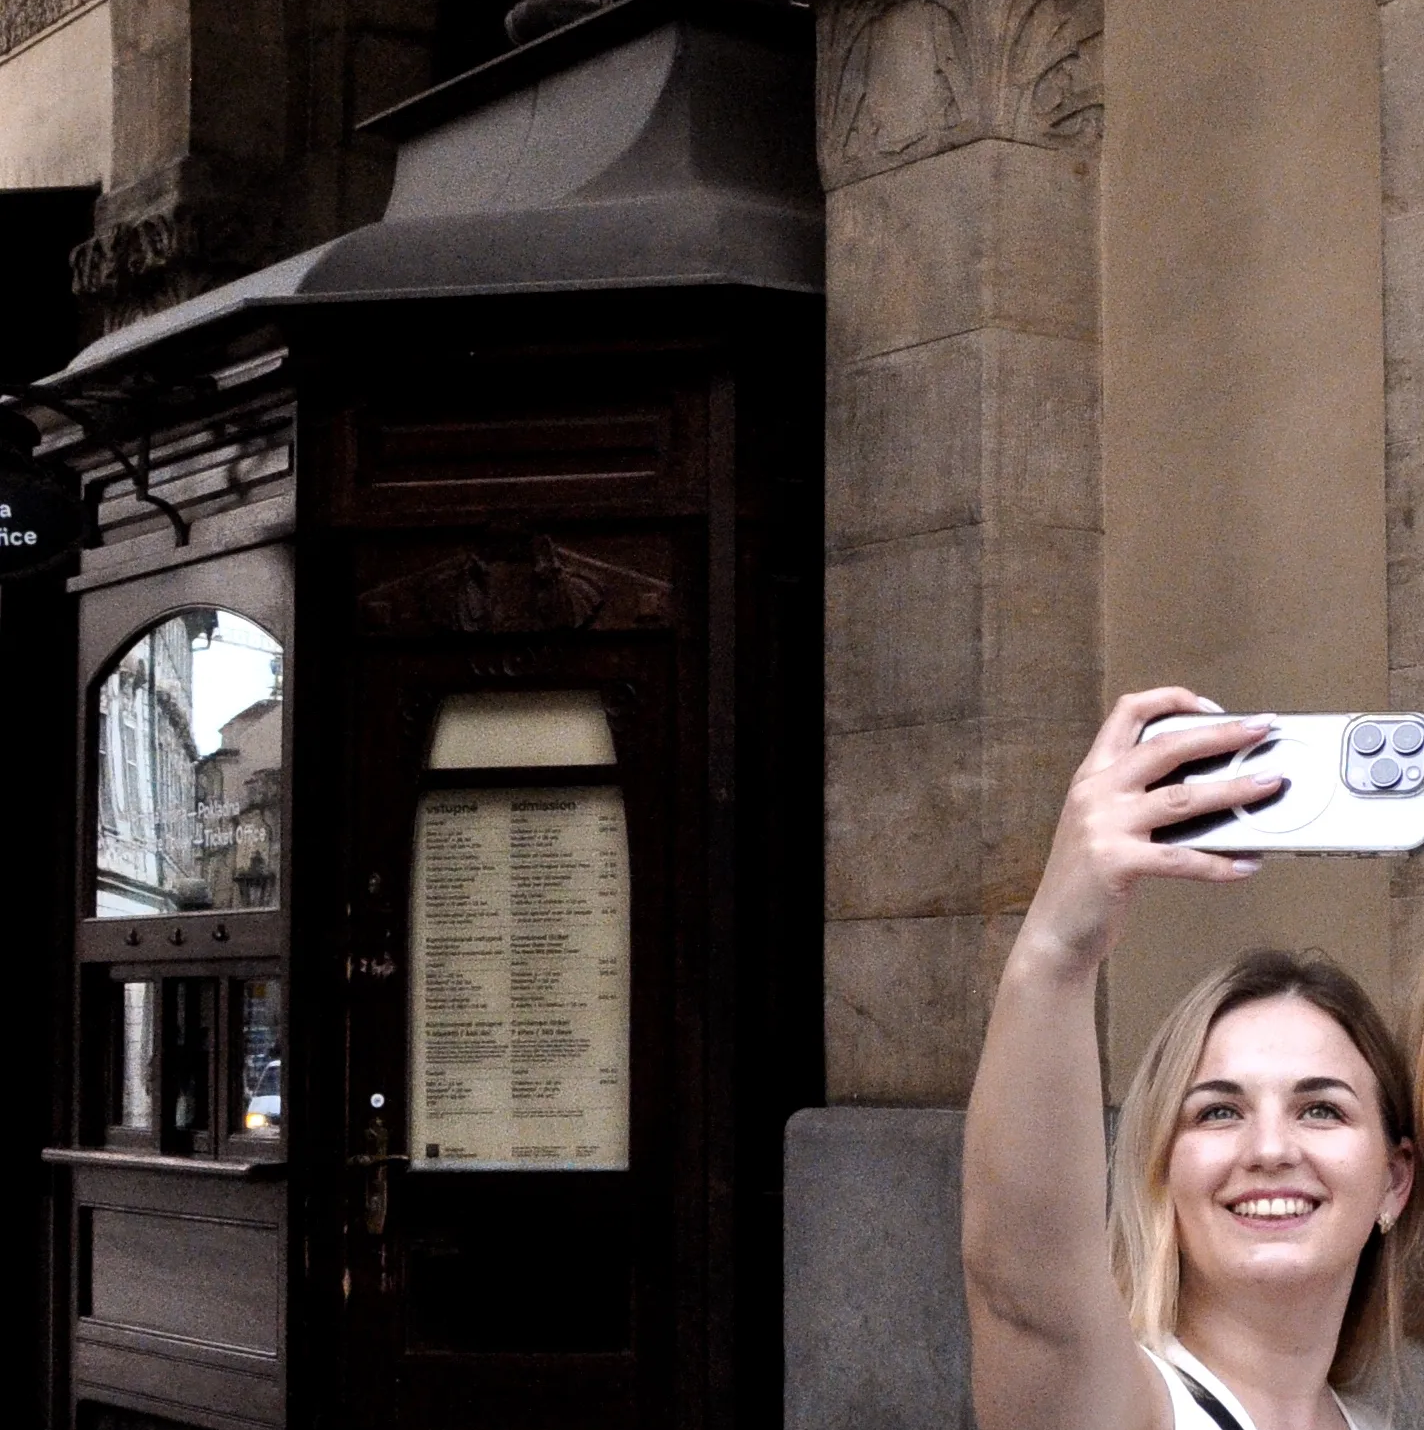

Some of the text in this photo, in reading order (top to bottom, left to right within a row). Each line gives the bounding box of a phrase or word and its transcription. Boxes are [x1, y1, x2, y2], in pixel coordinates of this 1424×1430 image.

[197, 801, 240, 820] Pokladna
[510, 800, 576, 812] admission
[204, 827, 234, 847] Ticket
[235, 824, 266, 844] Office
